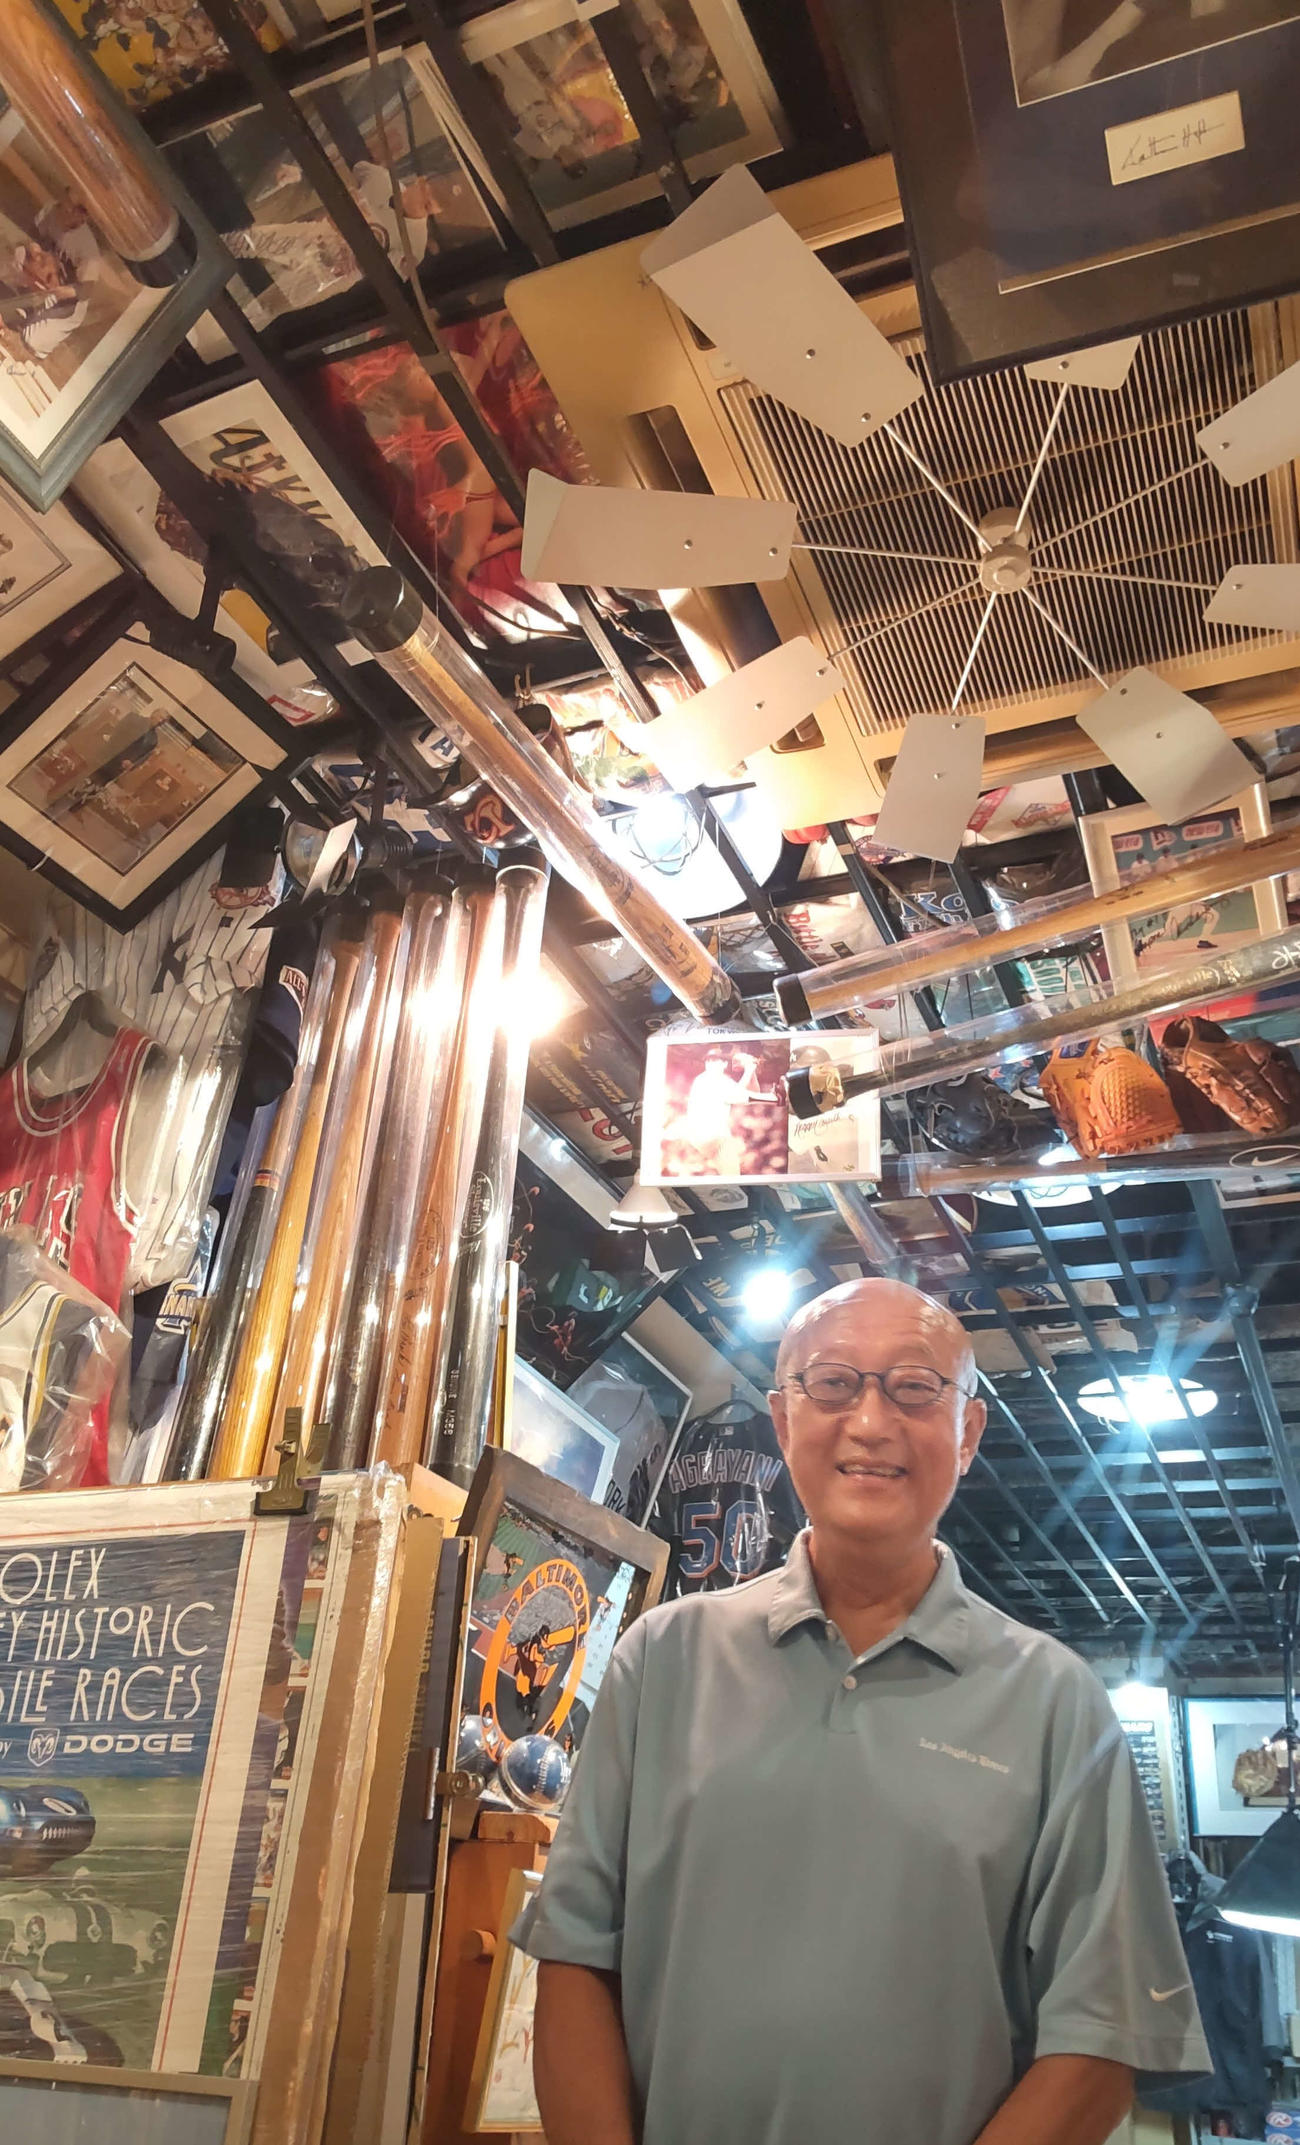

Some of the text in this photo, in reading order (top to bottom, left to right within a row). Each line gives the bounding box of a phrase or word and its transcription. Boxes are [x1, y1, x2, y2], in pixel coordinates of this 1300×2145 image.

[679, 1500, 768, 1580] 50
[0, 1547, 107, 1605] OLEX
[34, 1601, 215, 1662] HISTORIC
[69, 1664, 203, 1722] RACES
[63, 1732, 196, 1754] DODGE
